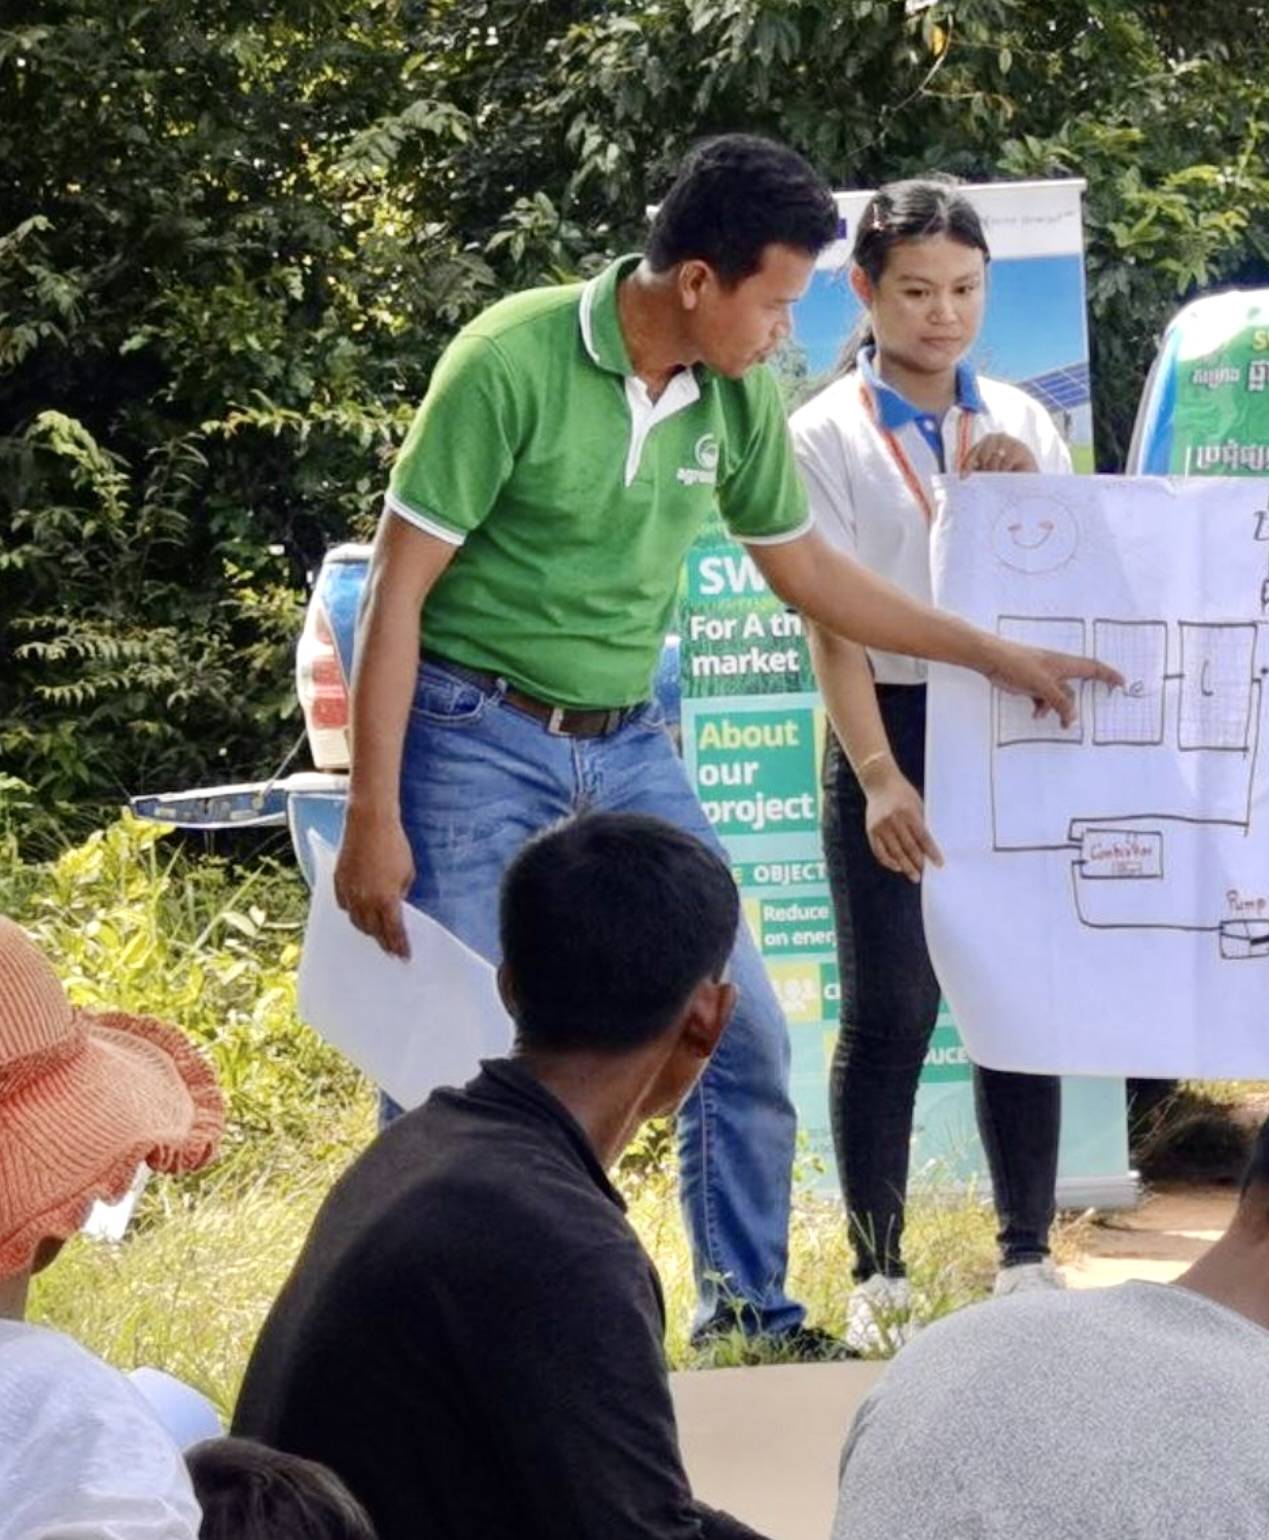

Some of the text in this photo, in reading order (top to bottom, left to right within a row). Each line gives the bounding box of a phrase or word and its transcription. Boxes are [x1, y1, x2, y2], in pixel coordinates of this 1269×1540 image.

[699, 555, 768, 596] SW
[690, 612, 802, 641] For A th
[692, 647, 800, 677] market
[700, 719, 800, 750] About
[700, 761, 759, 787] our
[701, 792, 815, 830] project
[754, 862, 826, 886] OBJECT
[763, 904, 829, 921] Reduce
[765, 930, 837, 948] on ener
[923, 1047, 969, 1066] UCE
